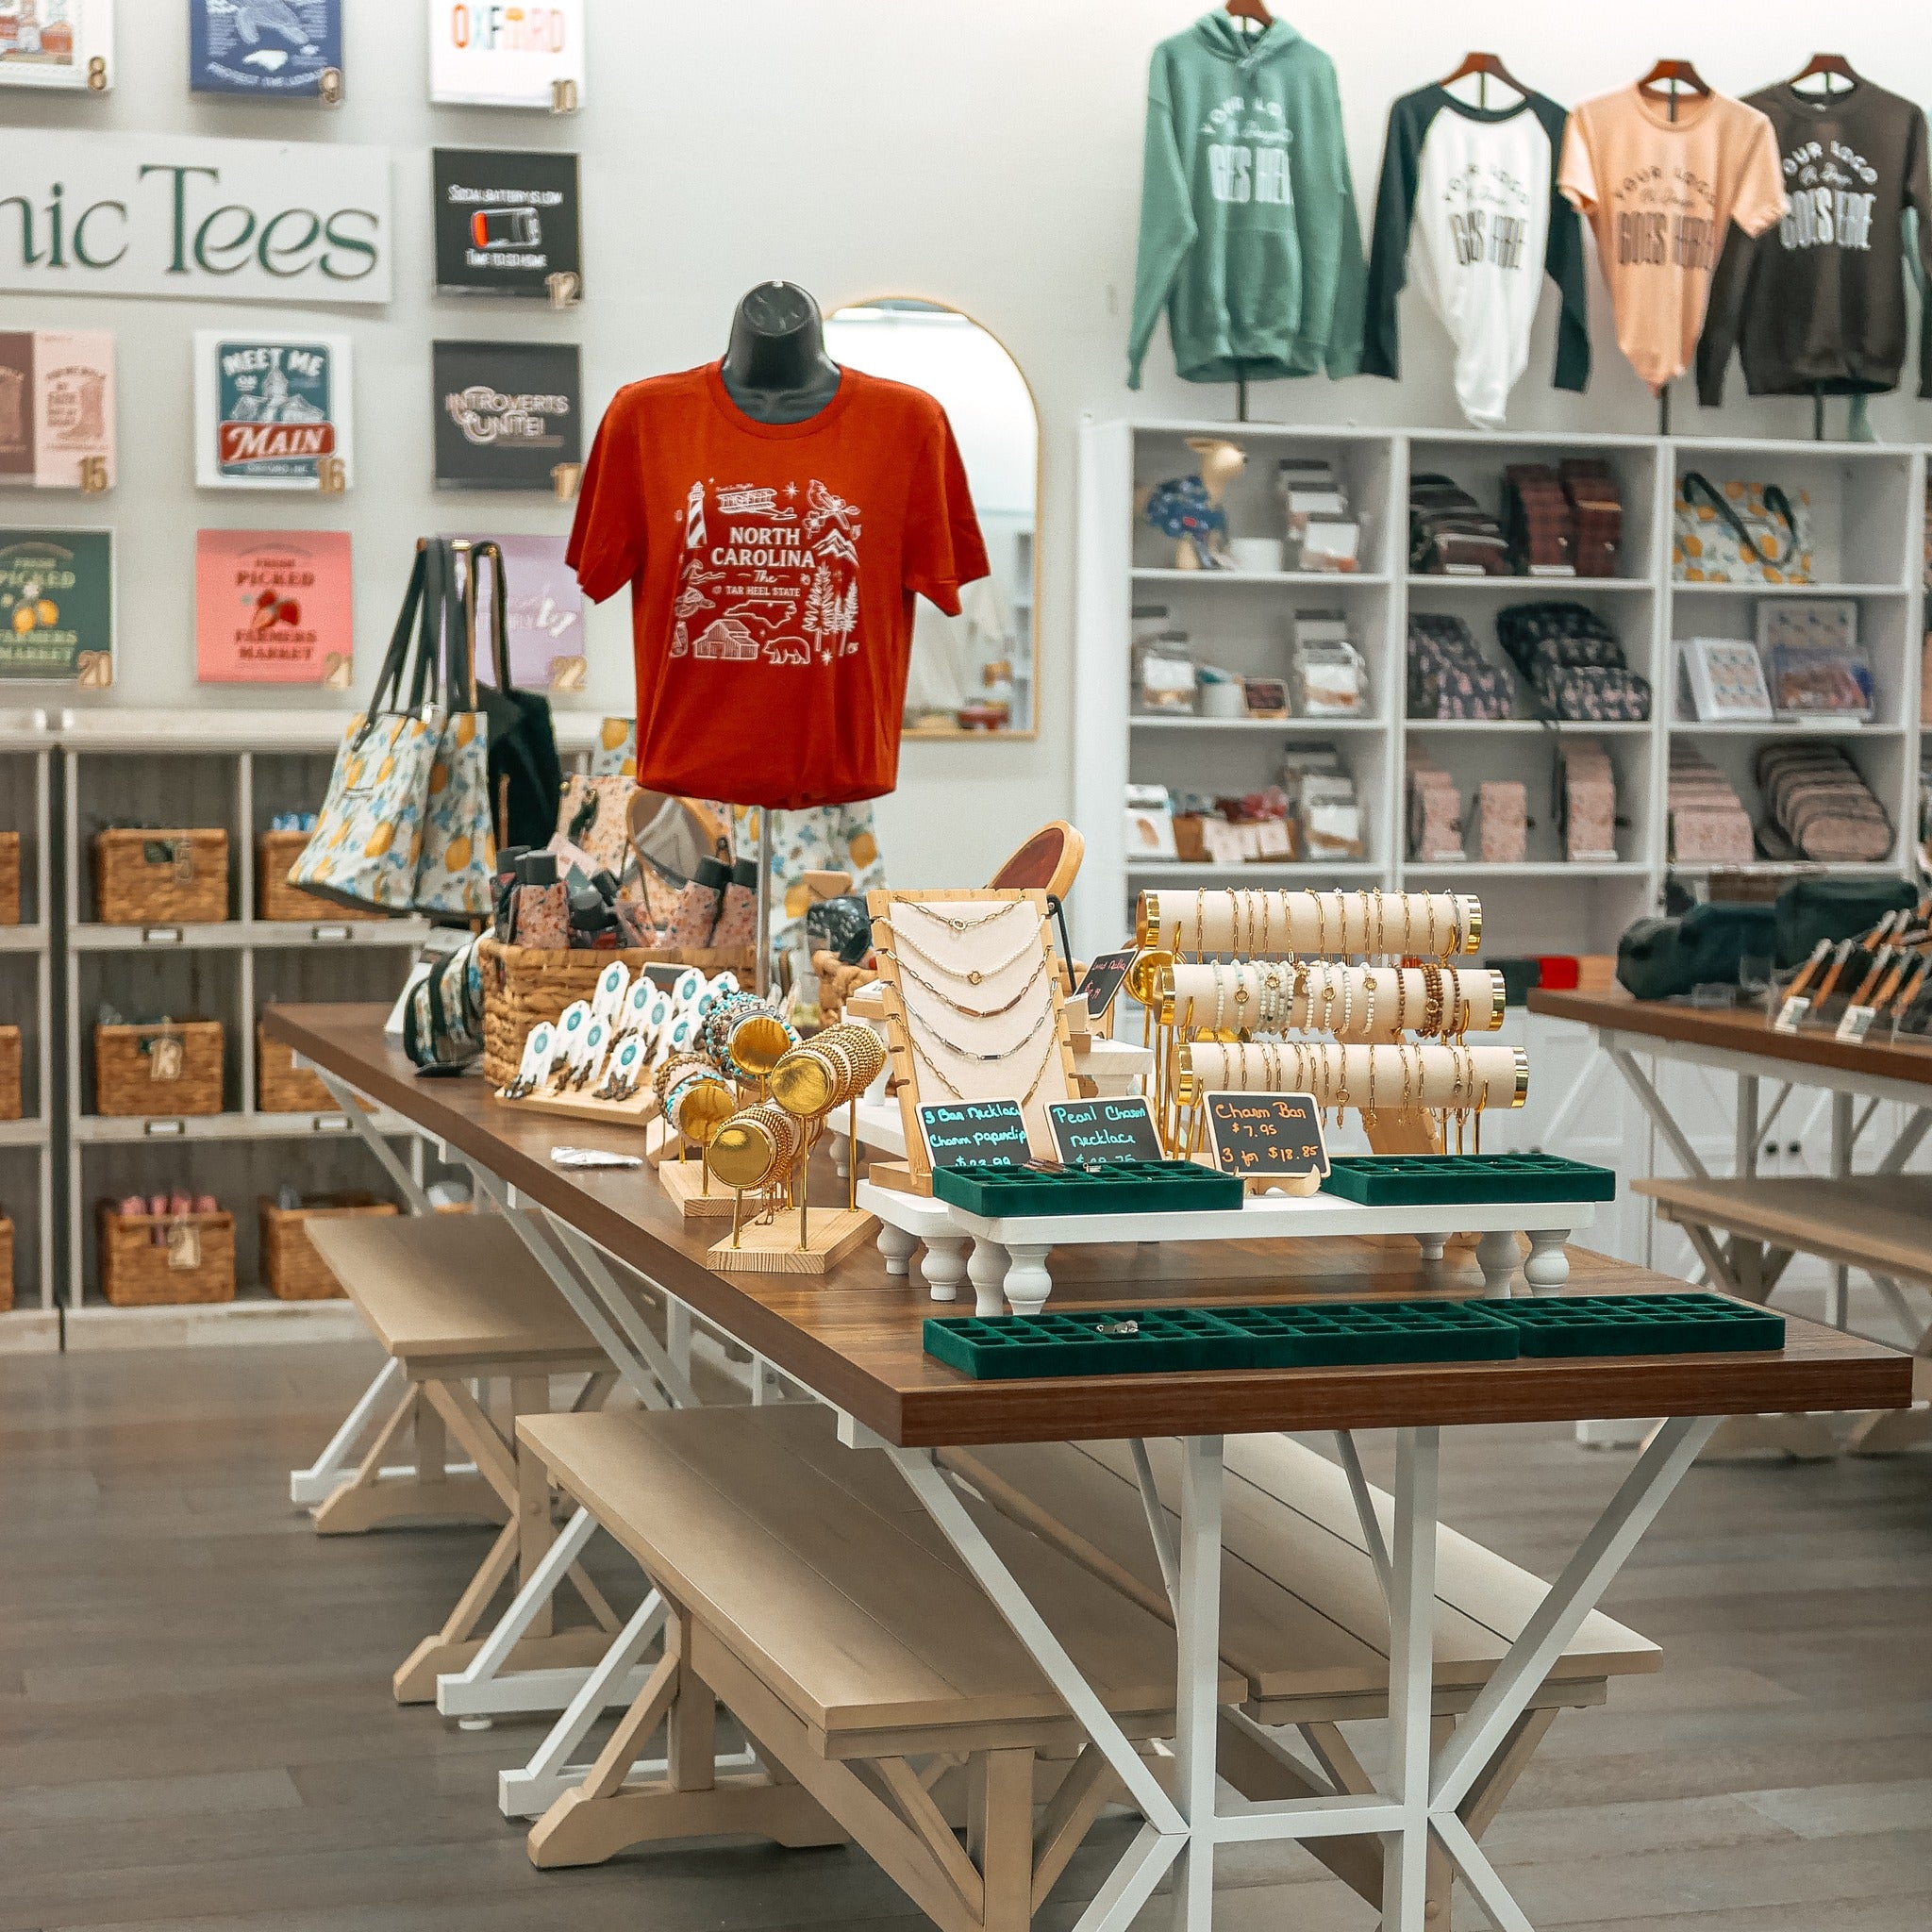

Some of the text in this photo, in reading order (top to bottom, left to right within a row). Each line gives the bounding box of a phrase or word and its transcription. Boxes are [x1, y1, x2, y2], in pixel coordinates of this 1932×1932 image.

[87, 56, 107, 92] 8
[1782, 141, 1823, 176] OUR
[140, 164, 379, 281] Tees
[222, 347, 325, 377] MEET ME
[77, 456, 108, 494] 15
[317, 458, 346, 495] 16
[729, 526, 801, 545] NORTH
[710, 547, 816, 568] CAROLINA
[235, 571, 315, 587] PICKED
[754, 569, 778, 583] The
[725, 585, 801, 597] TAR HEEL STATE
[239, 646, 313, 660] MARKET
[77, 650, 113, 689] 20
[549, 655, 589, 694] 22
[924, 1110, 936, 1124] 3
[937, 1108, 965, 1123] Bar
[1052, 1105, 1146, 1124] Pearl Charm
[1215, 1101, 1307, 1119] Charm Bar
[929, 1124, 1026, 1148] Charm paperclip
[1222, 1145, 1319, 1167] 3 for $18.85
